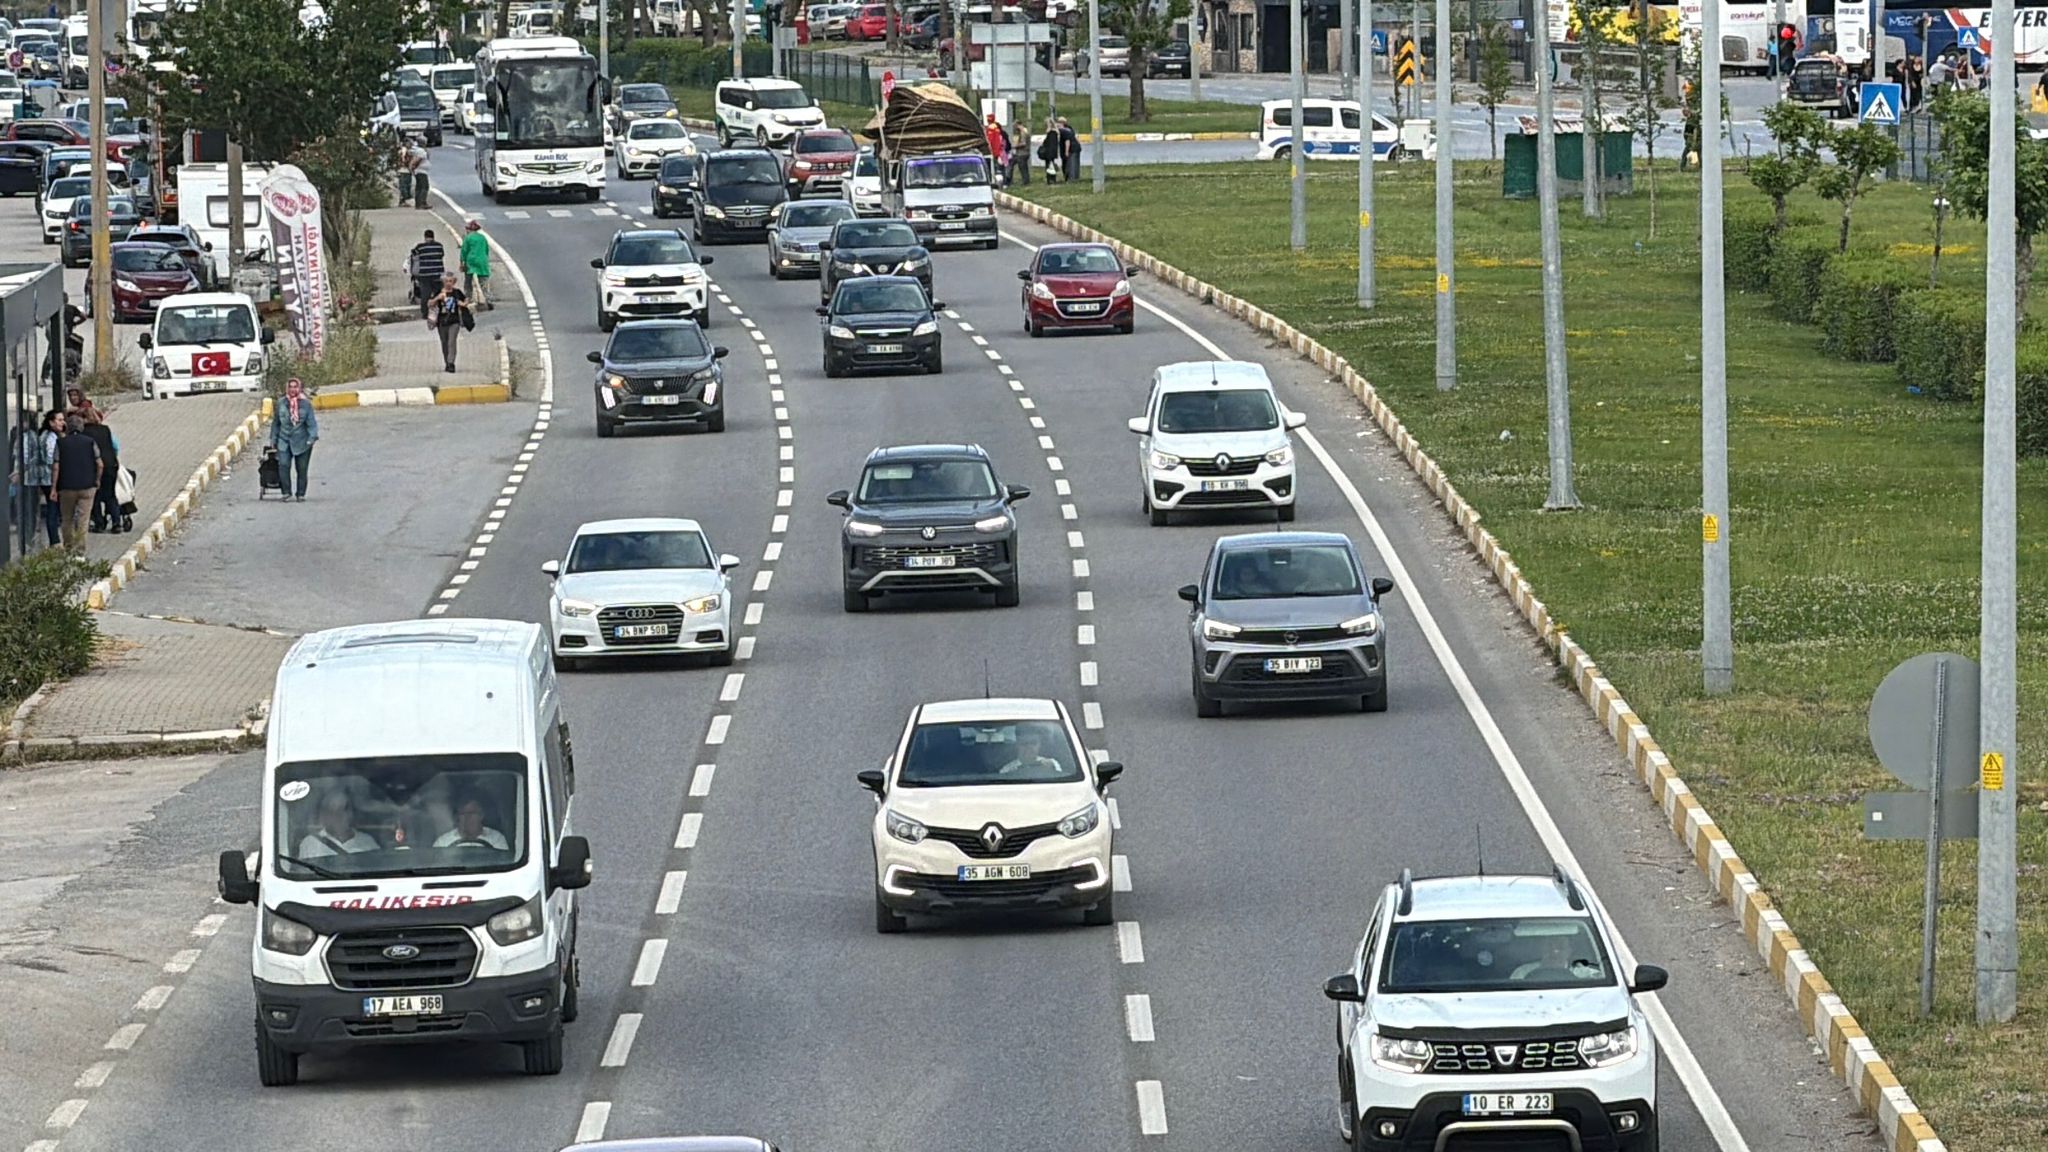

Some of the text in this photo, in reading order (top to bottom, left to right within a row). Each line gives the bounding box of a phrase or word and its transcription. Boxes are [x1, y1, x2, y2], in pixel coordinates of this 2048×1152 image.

[621, 626, 631, 637] 34
[633, 625, 649, 636] BNP
[1269, 660, 1280, 670] 35
[1304, 658, 1320, 669] 123
[965, 867, 978, 879] 35
[984, 867, 1003, 878] AGN
[372, 996, 442, 1012] 17 AEA 968
[1472, 1095, 1550, 1110] 10 ER 223
